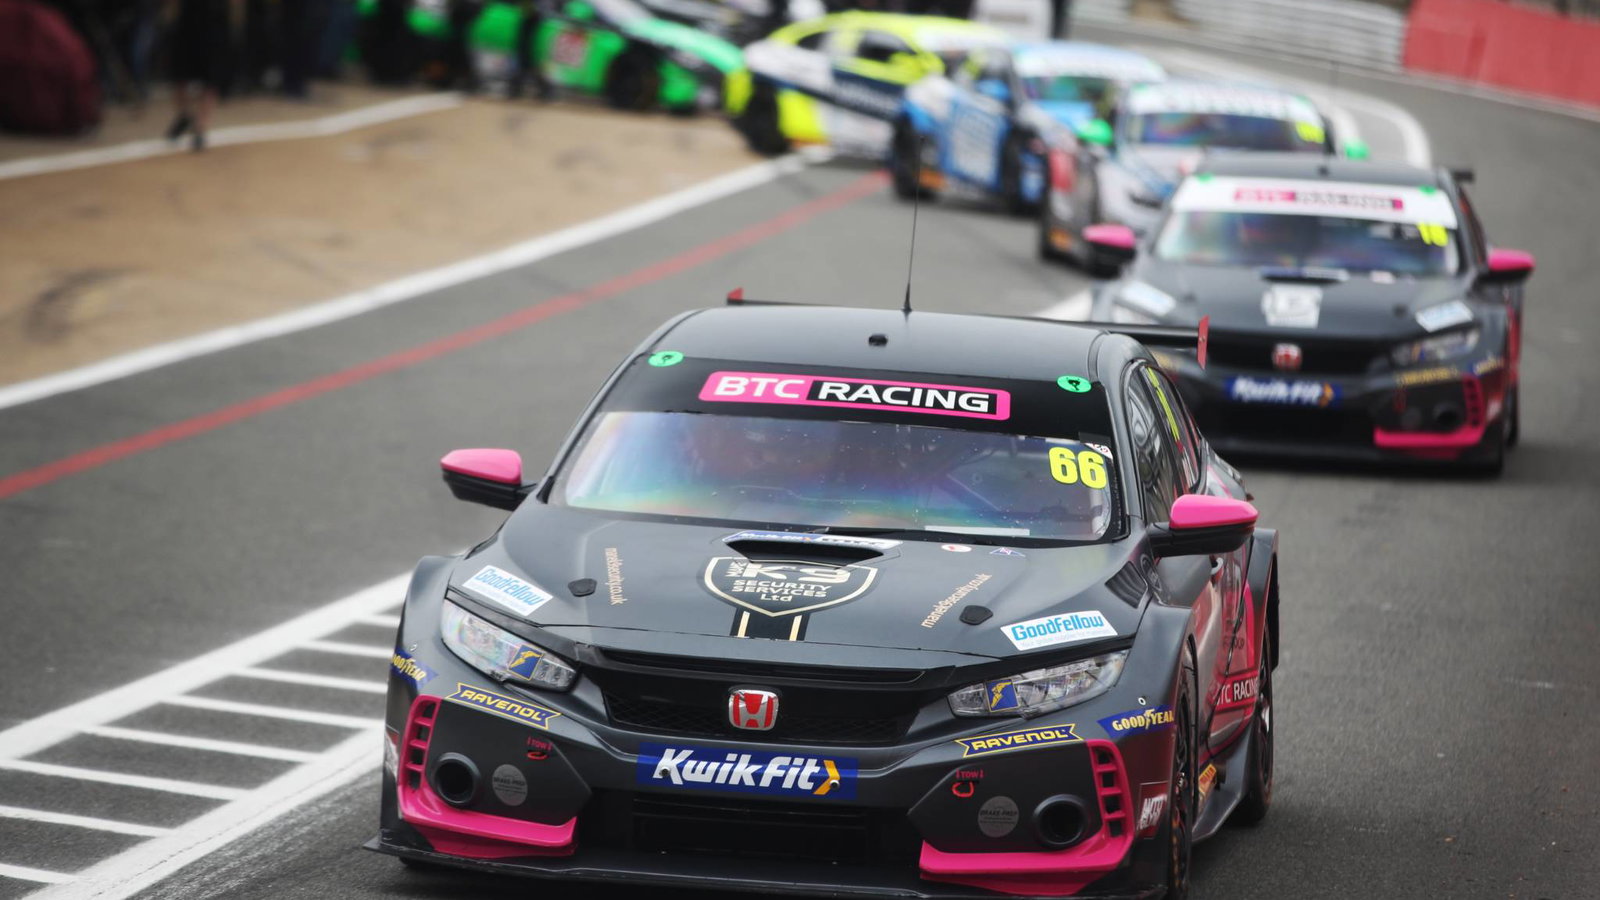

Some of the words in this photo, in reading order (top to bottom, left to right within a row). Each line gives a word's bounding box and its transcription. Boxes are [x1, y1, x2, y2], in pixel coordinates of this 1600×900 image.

[714, 376, 804, 398] BTC
[818, 382, 989, 413] RACING
[1048, 446, 1107, 489] 66
[475, 568, 544, 606] GoodFellow
[731, 586, 827, 598] SERVICES
[733, 580, 832, 591] SECURITY
[760, 593, 793, 602] Ltd
[1011, 615, 1105, 641] GoodFellow
[1233, 677, 1257, 702] RACIN
[460, 689, 545, 722] RAVENOL
[971, 729, 1067, 751] RAVENOL
